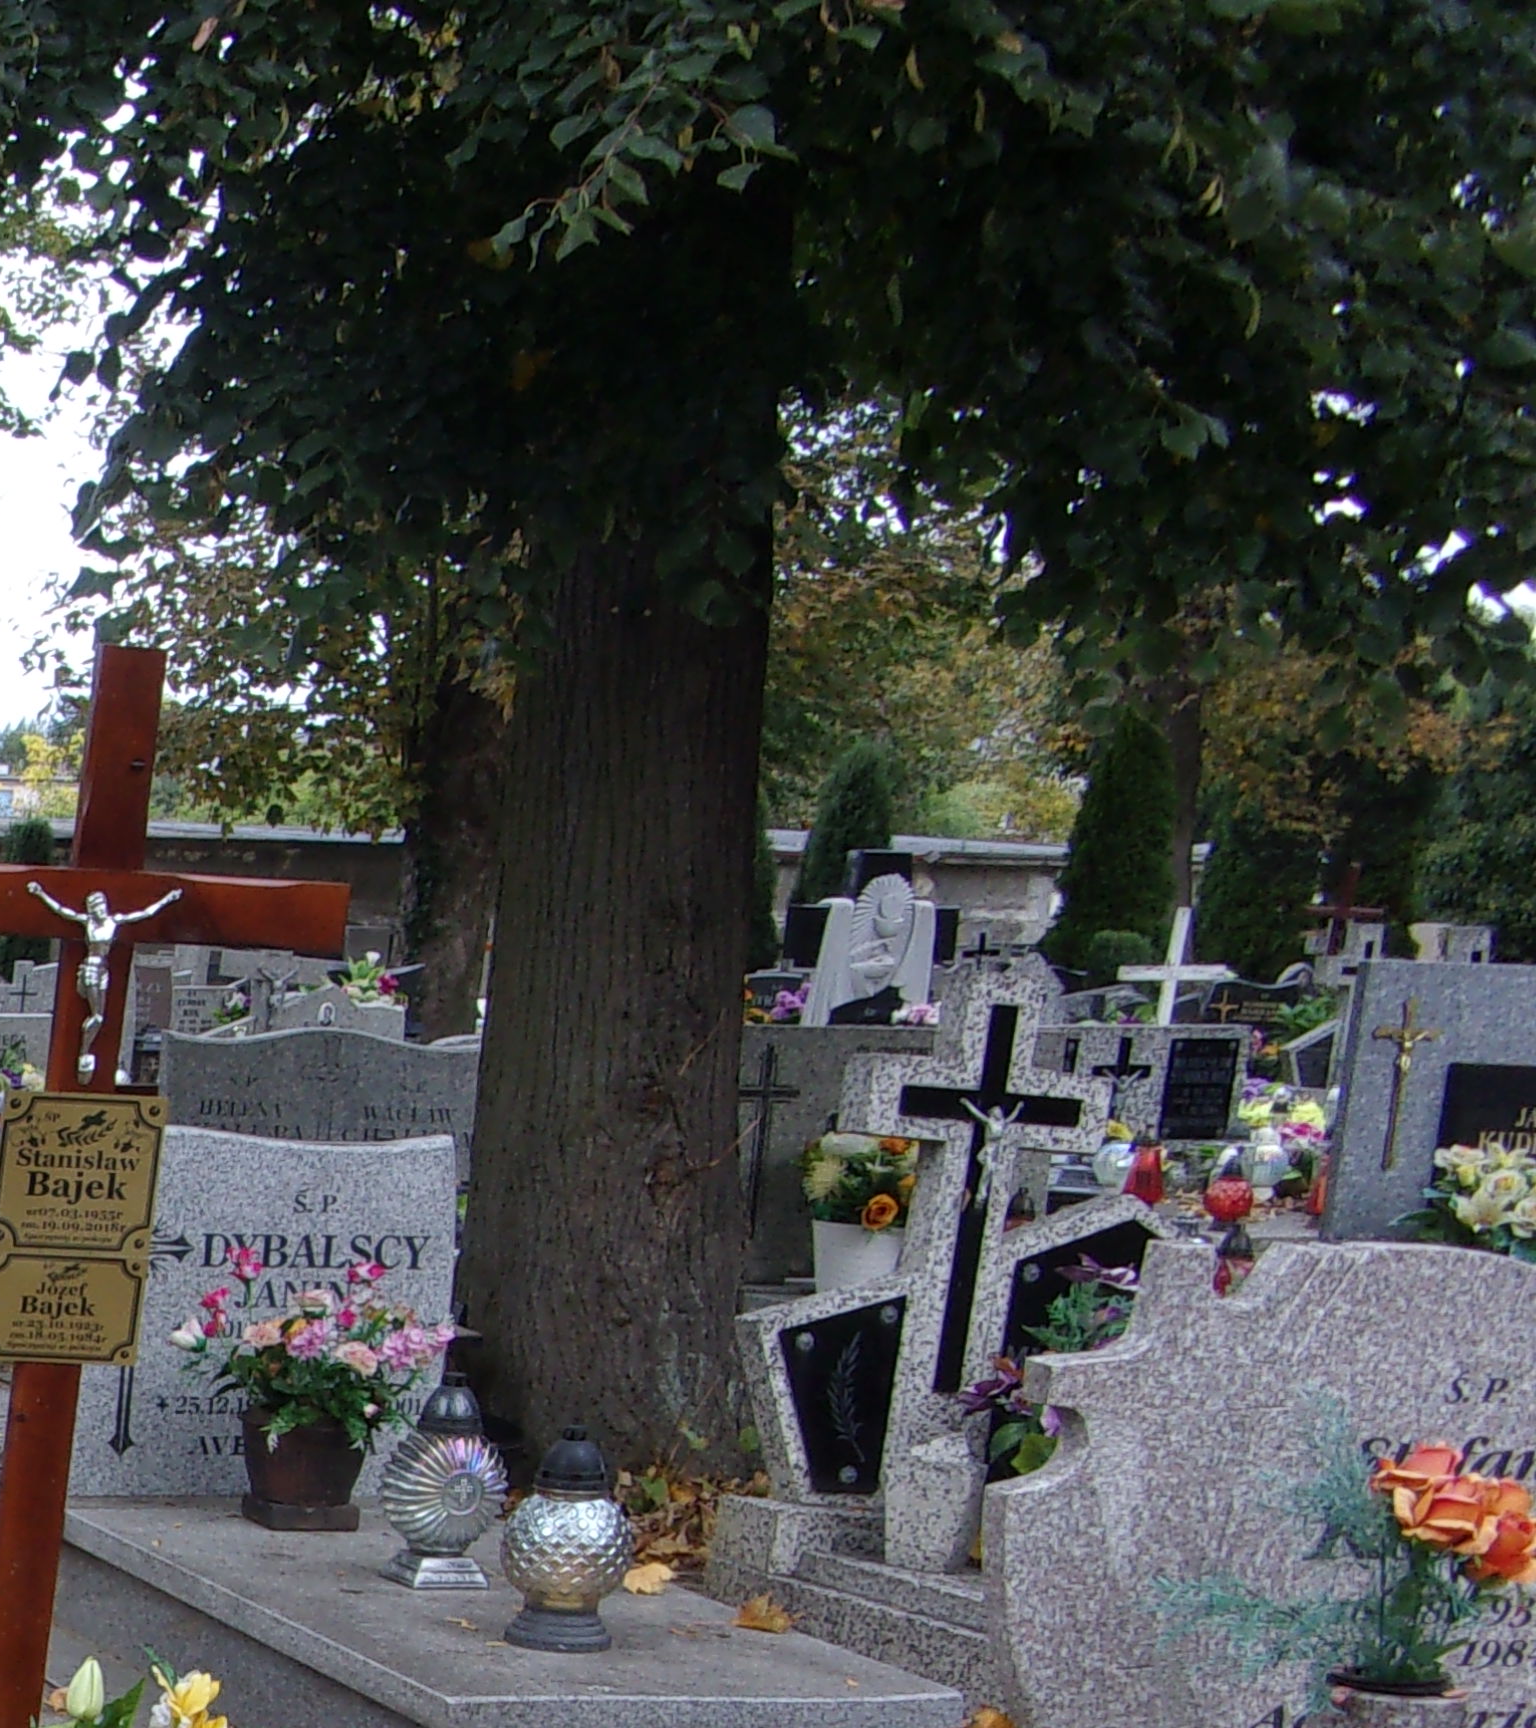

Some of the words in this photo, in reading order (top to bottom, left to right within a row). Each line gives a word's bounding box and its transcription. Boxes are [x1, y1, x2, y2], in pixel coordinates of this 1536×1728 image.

[25, 1171, 128, 1206] Bajek
[200, 1232, 433, 1270] DYBALSCY
[20, 1295, 96, 1319] Bajek
[1456, 1639, 1536, 1669] 198
